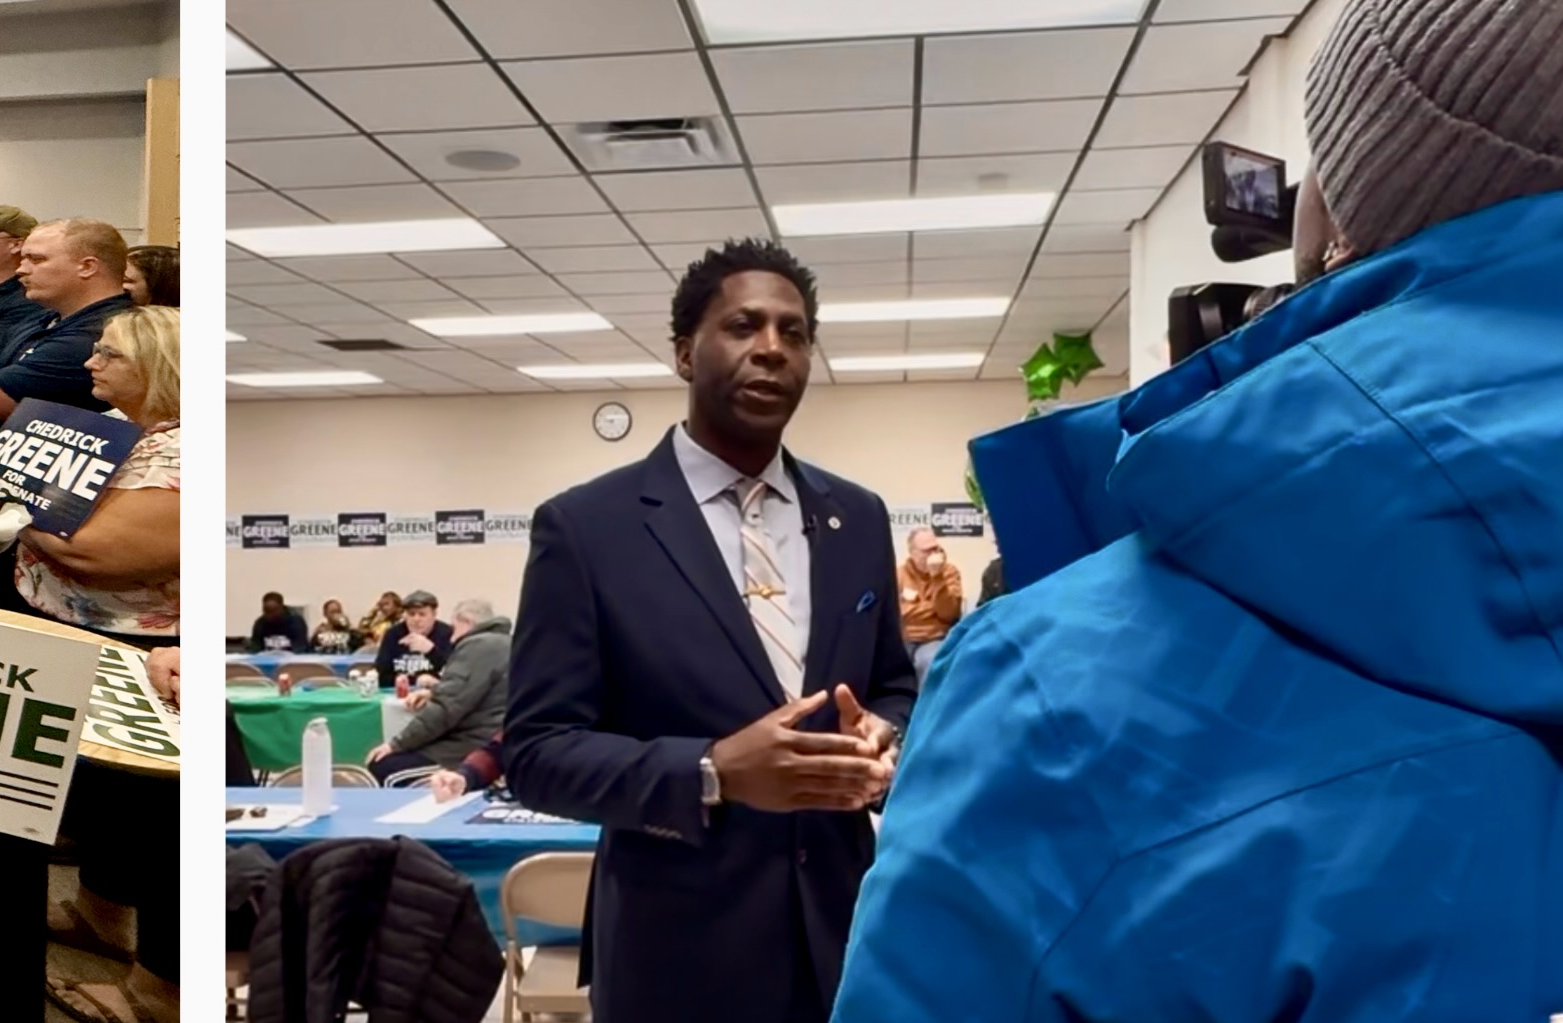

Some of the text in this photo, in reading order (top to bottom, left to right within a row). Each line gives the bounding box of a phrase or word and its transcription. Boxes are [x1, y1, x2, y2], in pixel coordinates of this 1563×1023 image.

[25, 419, 110, 455] CHEDRICK
[2, 469, 27, 486] FOR
[485, 519, 532, 531] GREEN
[887, 513, 928, 525] REENE
[290, 524, 336, 536] GREENE
[387, 522, 434, 533] GREENE
